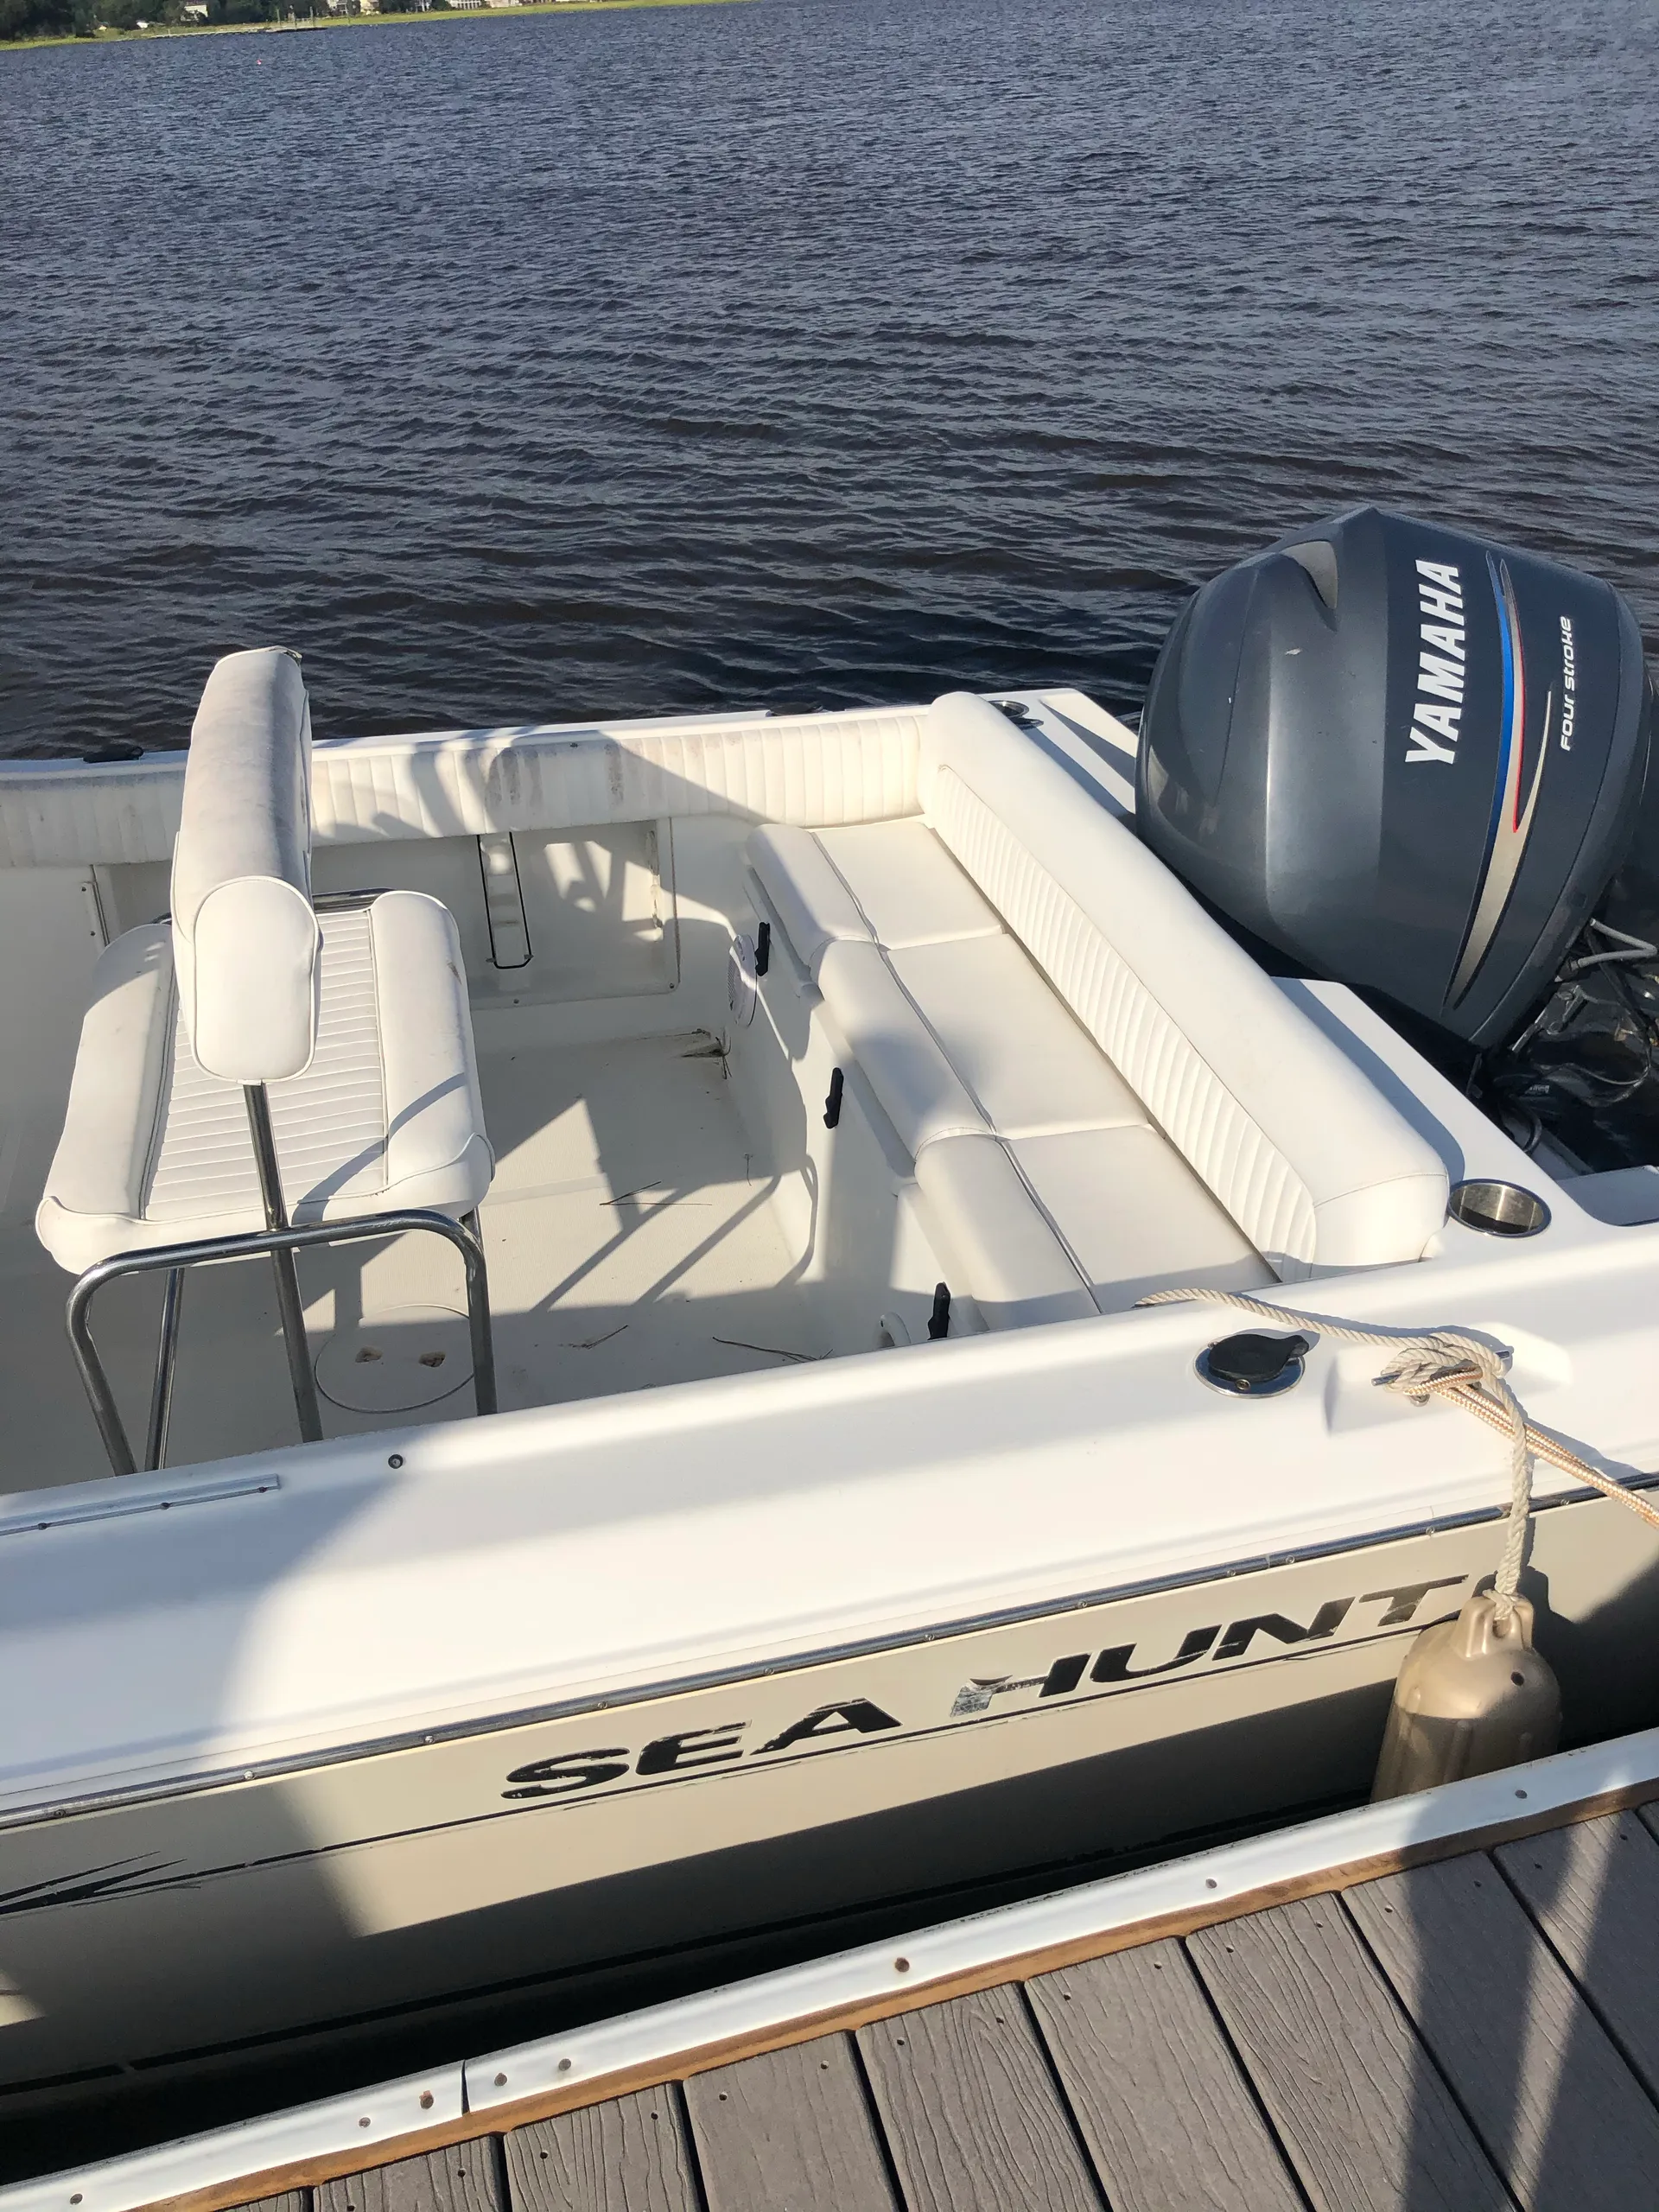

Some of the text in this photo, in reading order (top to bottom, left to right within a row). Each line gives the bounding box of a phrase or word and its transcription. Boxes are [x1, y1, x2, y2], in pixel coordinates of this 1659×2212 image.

[1405, 560, 1465, 765] YAMAHA
[500, 1574, 1469, 1799] SEA HUNT
